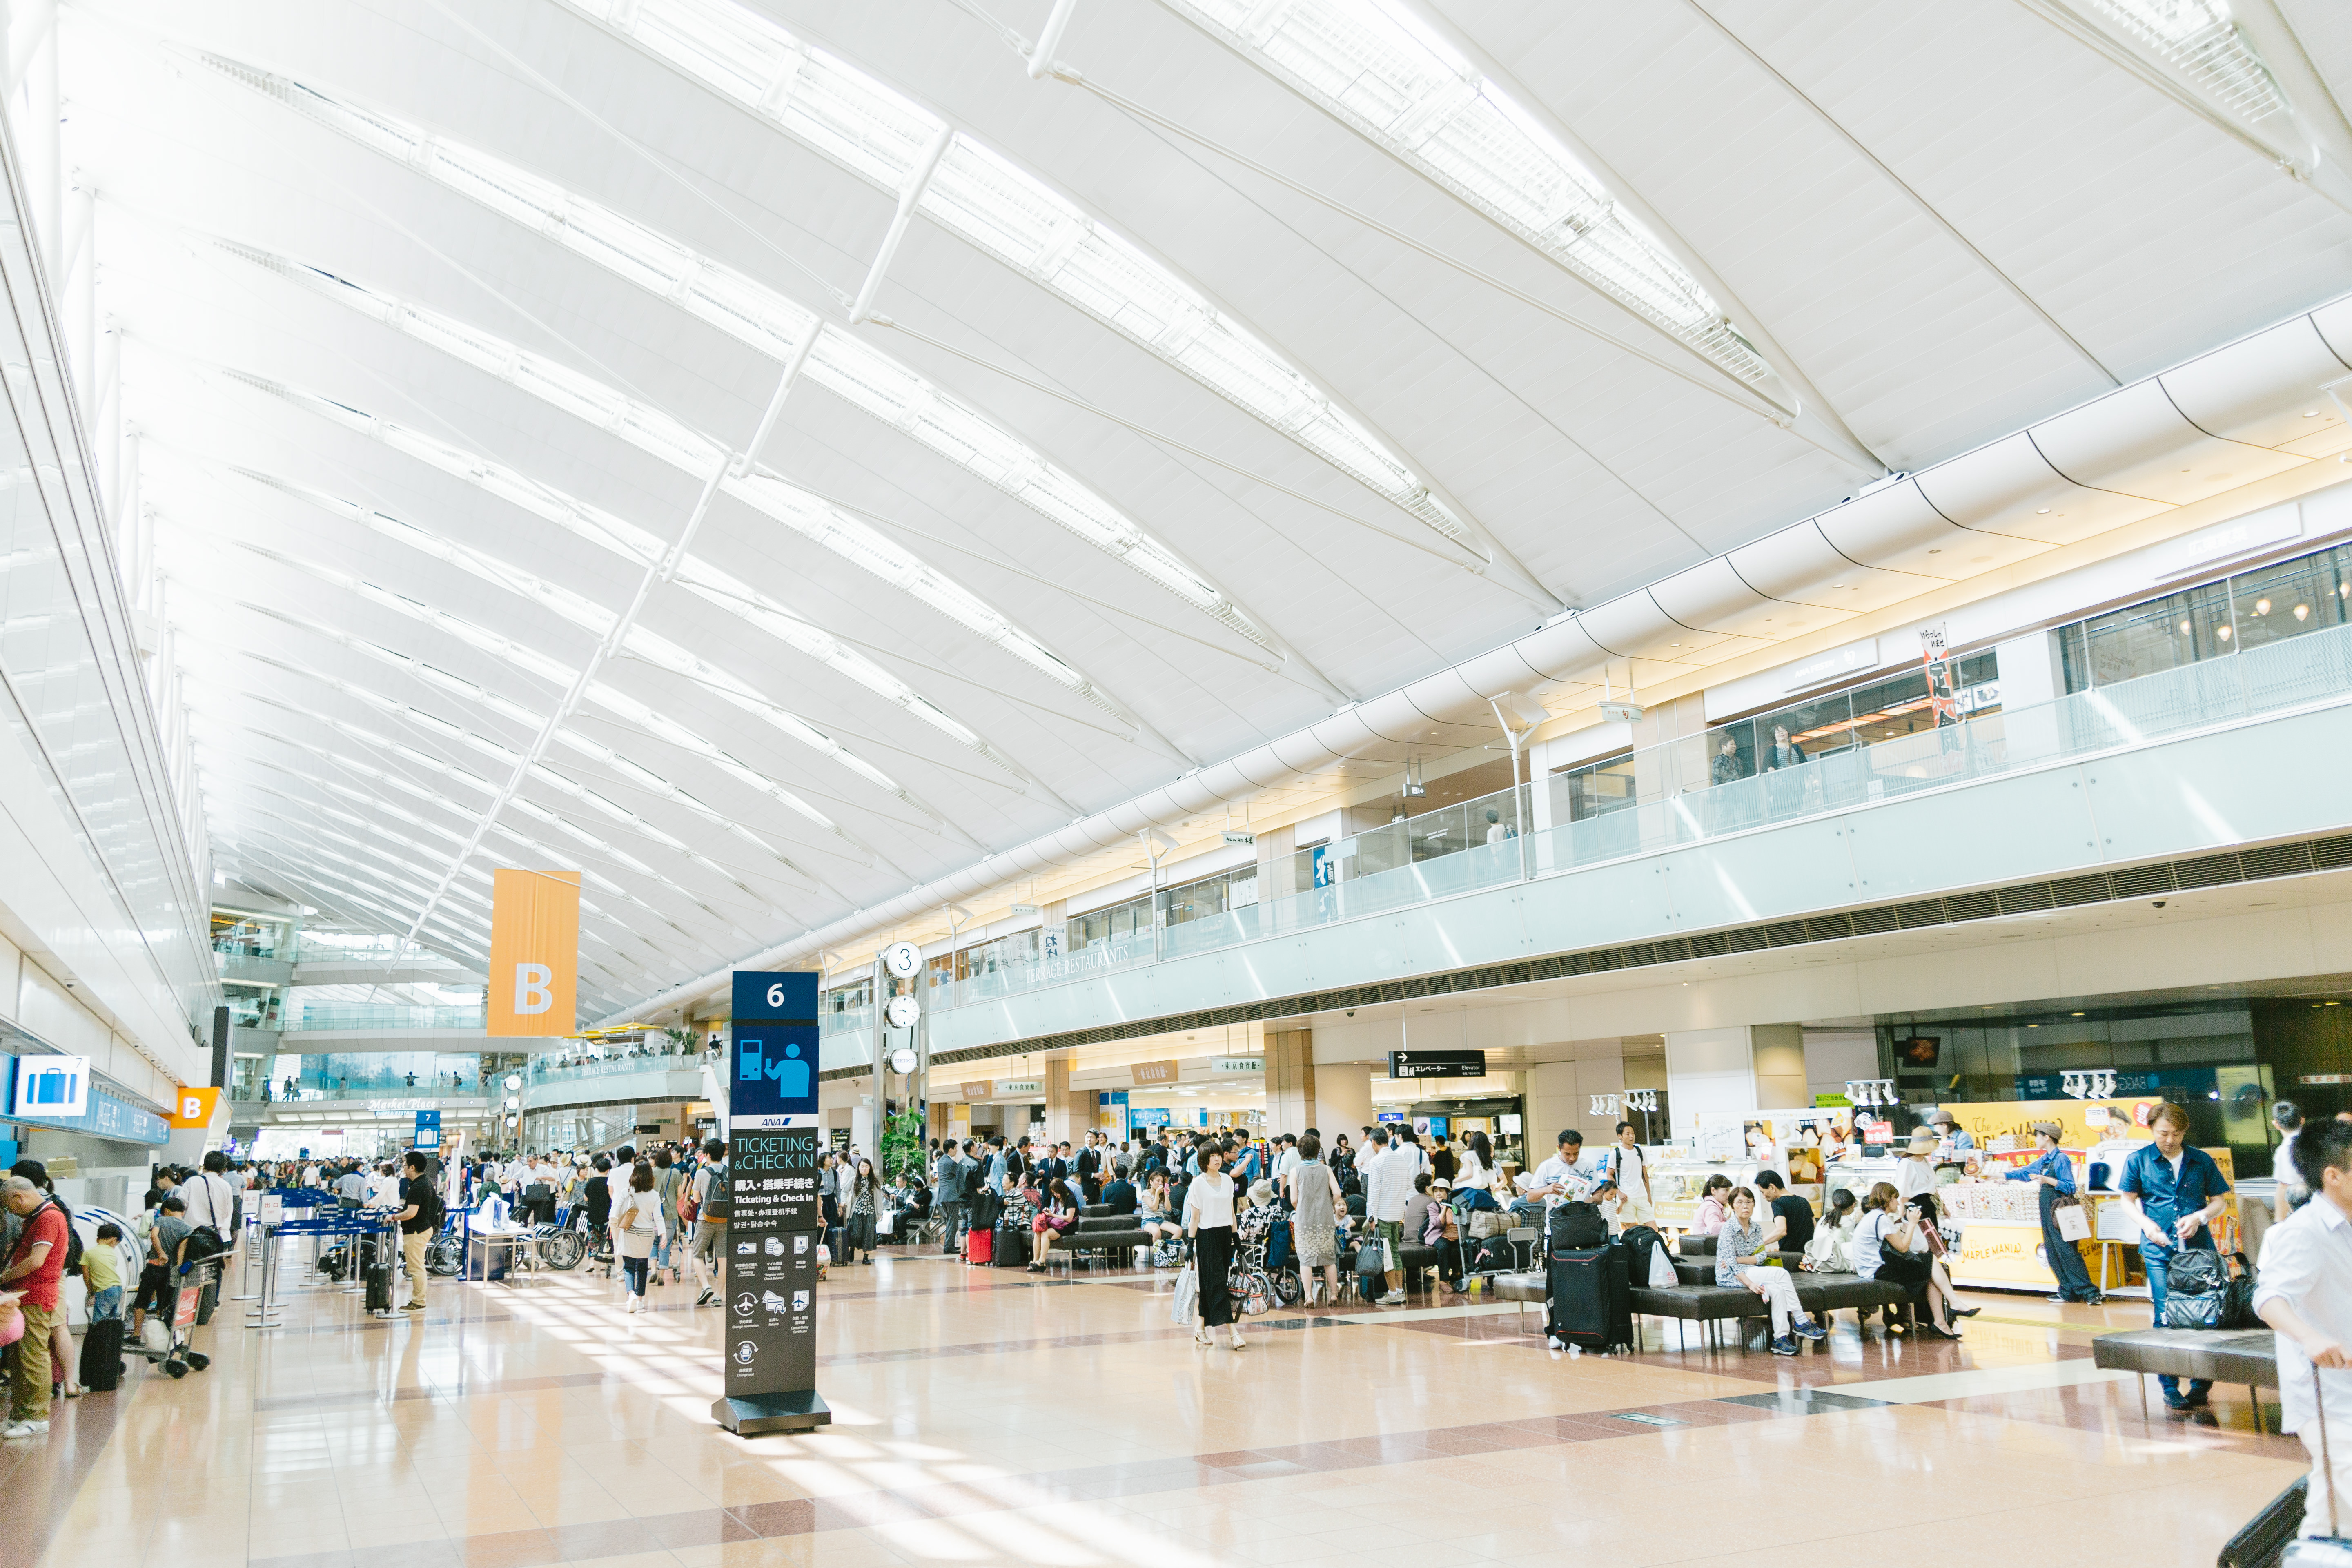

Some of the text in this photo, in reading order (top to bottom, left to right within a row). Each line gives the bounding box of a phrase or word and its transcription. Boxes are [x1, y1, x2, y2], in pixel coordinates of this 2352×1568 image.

[899, 949, 911, 970] 3
[1025, 962, 1062, 984] TERRACE
[1064, 945, 1129, 975] RESTAURANTS
[515, 963, 553, 1014] B
[767, 983, 784, 1007] 6
[581, 1062, 634, 1076] TERRACE RESTAURANTS
[183, 1097, 201, 1119] B
[367, 1097, 436, 1109] Market Place
[735, 1136, 813, 1153] TICKETING
[799, 1154, 813, 1168] IN
[735, 1178, 814, 1192] 購入・搭乗手続き
[734, 1193, 814, 1205] Ticketing & Check In
[1962, 1248, 1990, 1263] MAPLE
